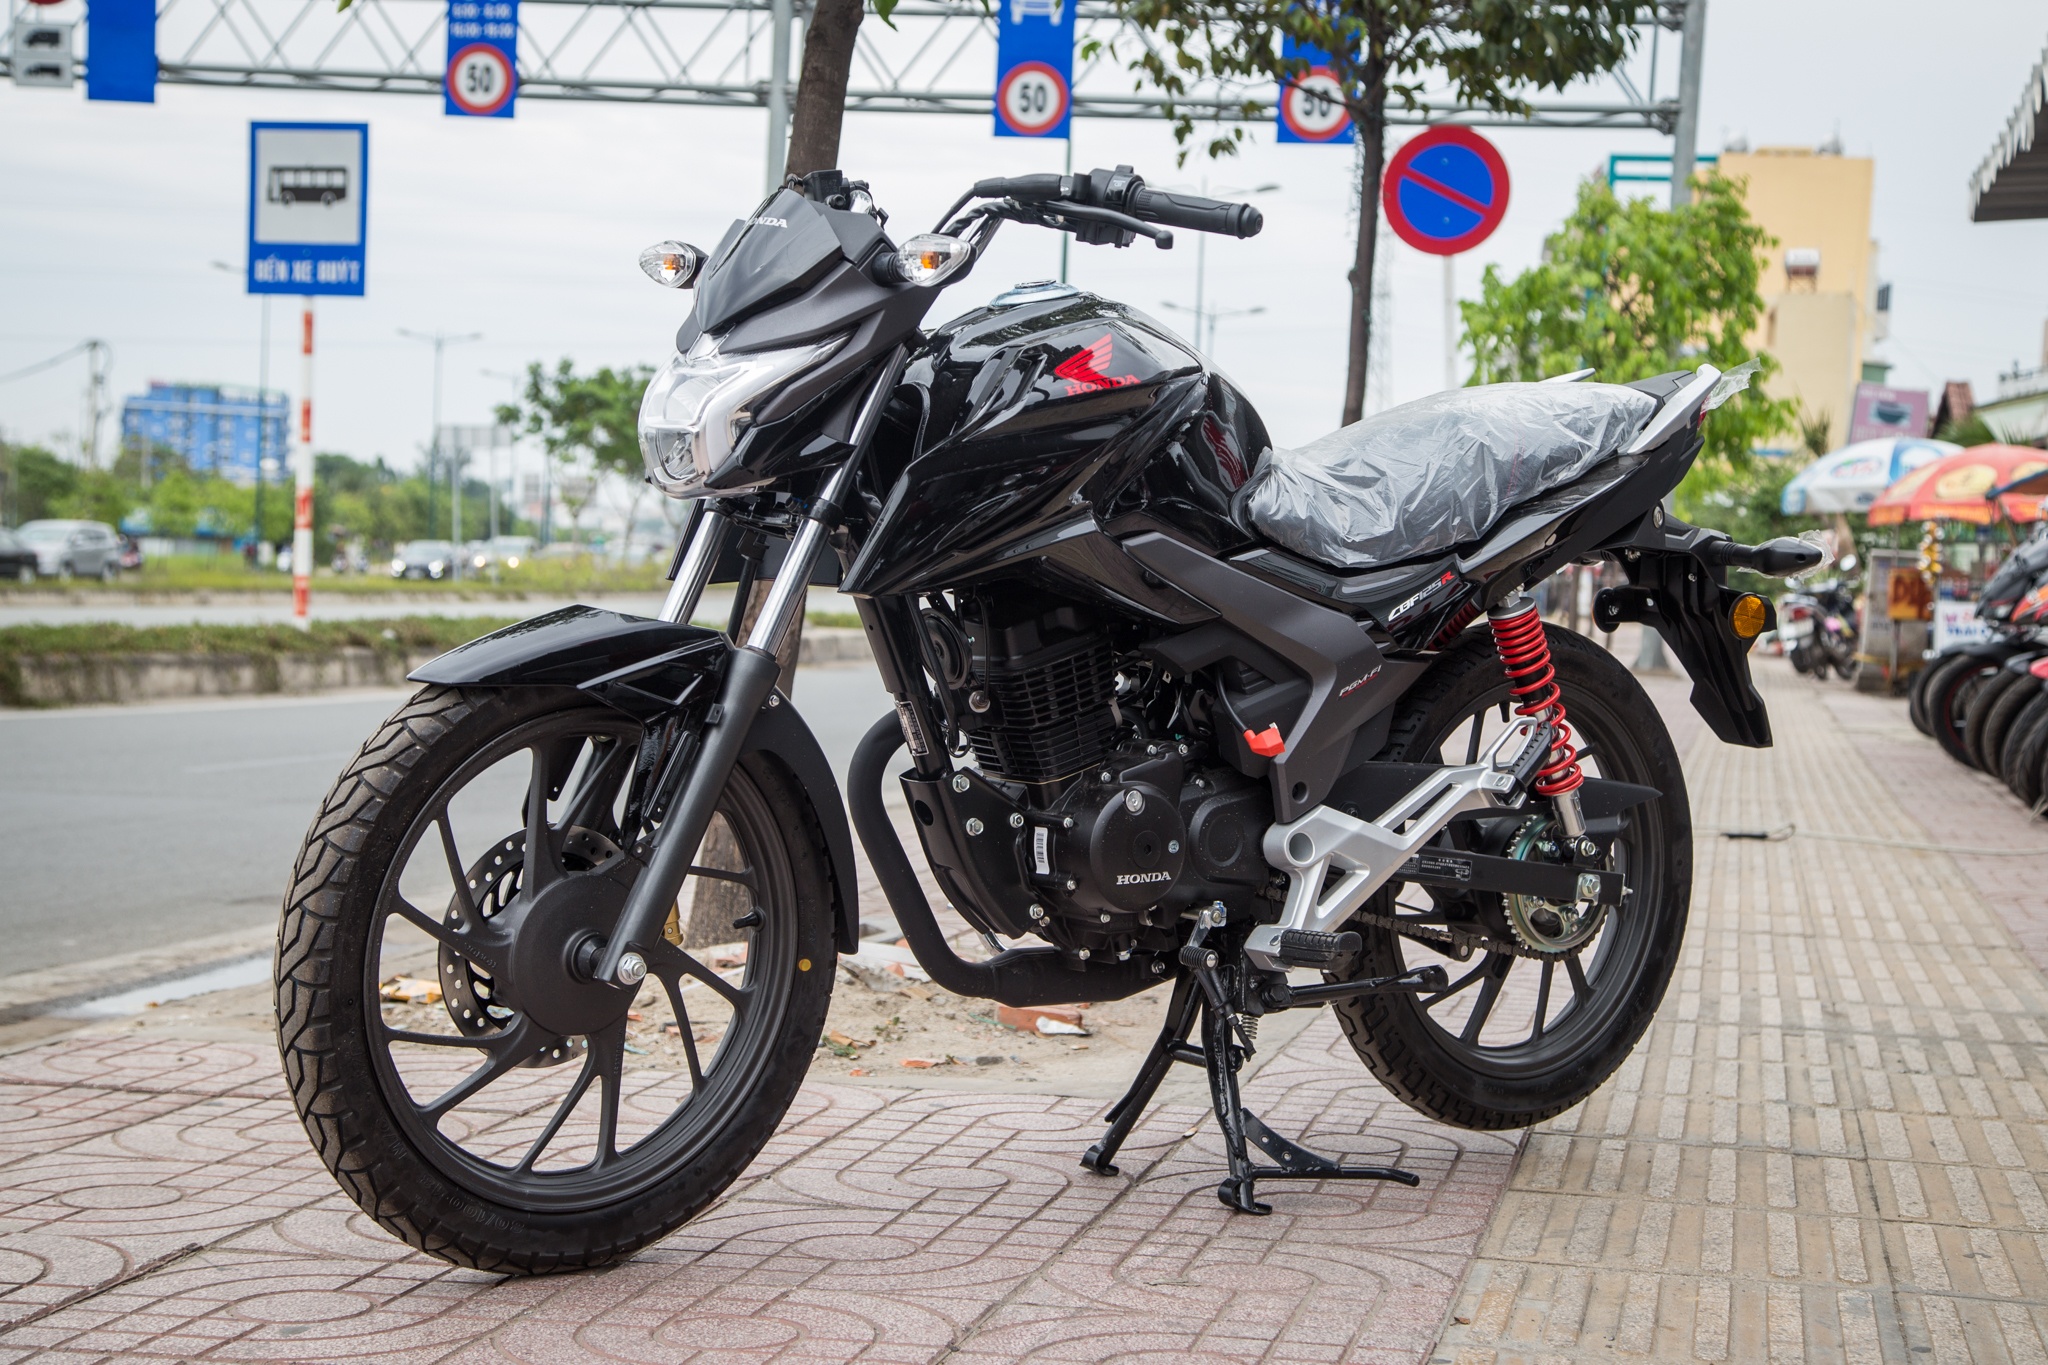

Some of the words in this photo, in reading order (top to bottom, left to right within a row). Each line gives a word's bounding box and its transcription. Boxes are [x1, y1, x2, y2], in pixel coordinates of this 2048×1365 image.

[467, 64, 493, 93] 50
[1020, 84, 1047, 114] 50
[1303, 86, 1332, 118] 50
[254, 252, 290, 283] BẾN
[291, 259, 314, 284] XE
[316, 256, 361, 284] BUÝT
[1064, 374, 1142, 396] HONDA
[1388, 571, 1455, 622] CBF125R
[1339, 664, 1382, 697] PGM-FI
[1116, 871, 1172, 885] HONDA
